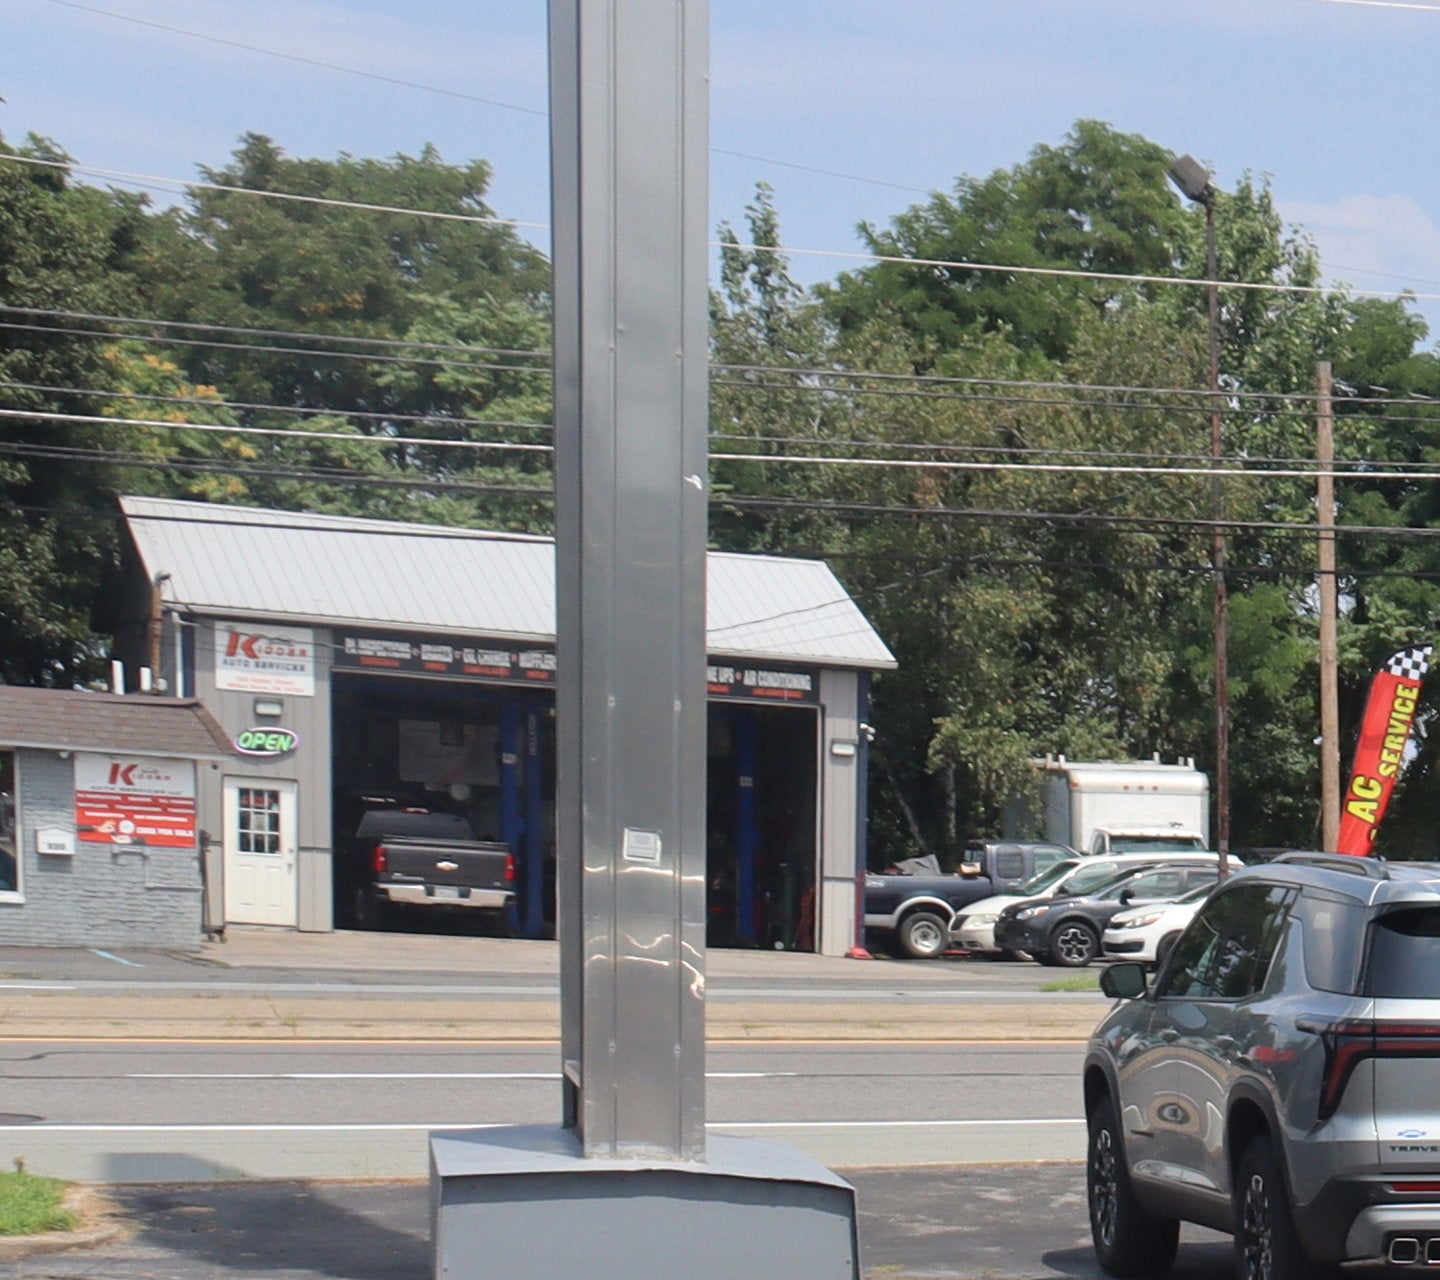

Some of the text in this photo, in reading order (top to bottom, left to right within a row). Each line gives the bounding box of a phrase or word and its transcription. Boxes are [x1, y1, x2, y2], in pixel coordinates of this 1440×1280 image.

[238, 731, 292, 751] OPEN
[1346, 683, 1420, 824] AC SERVICE
